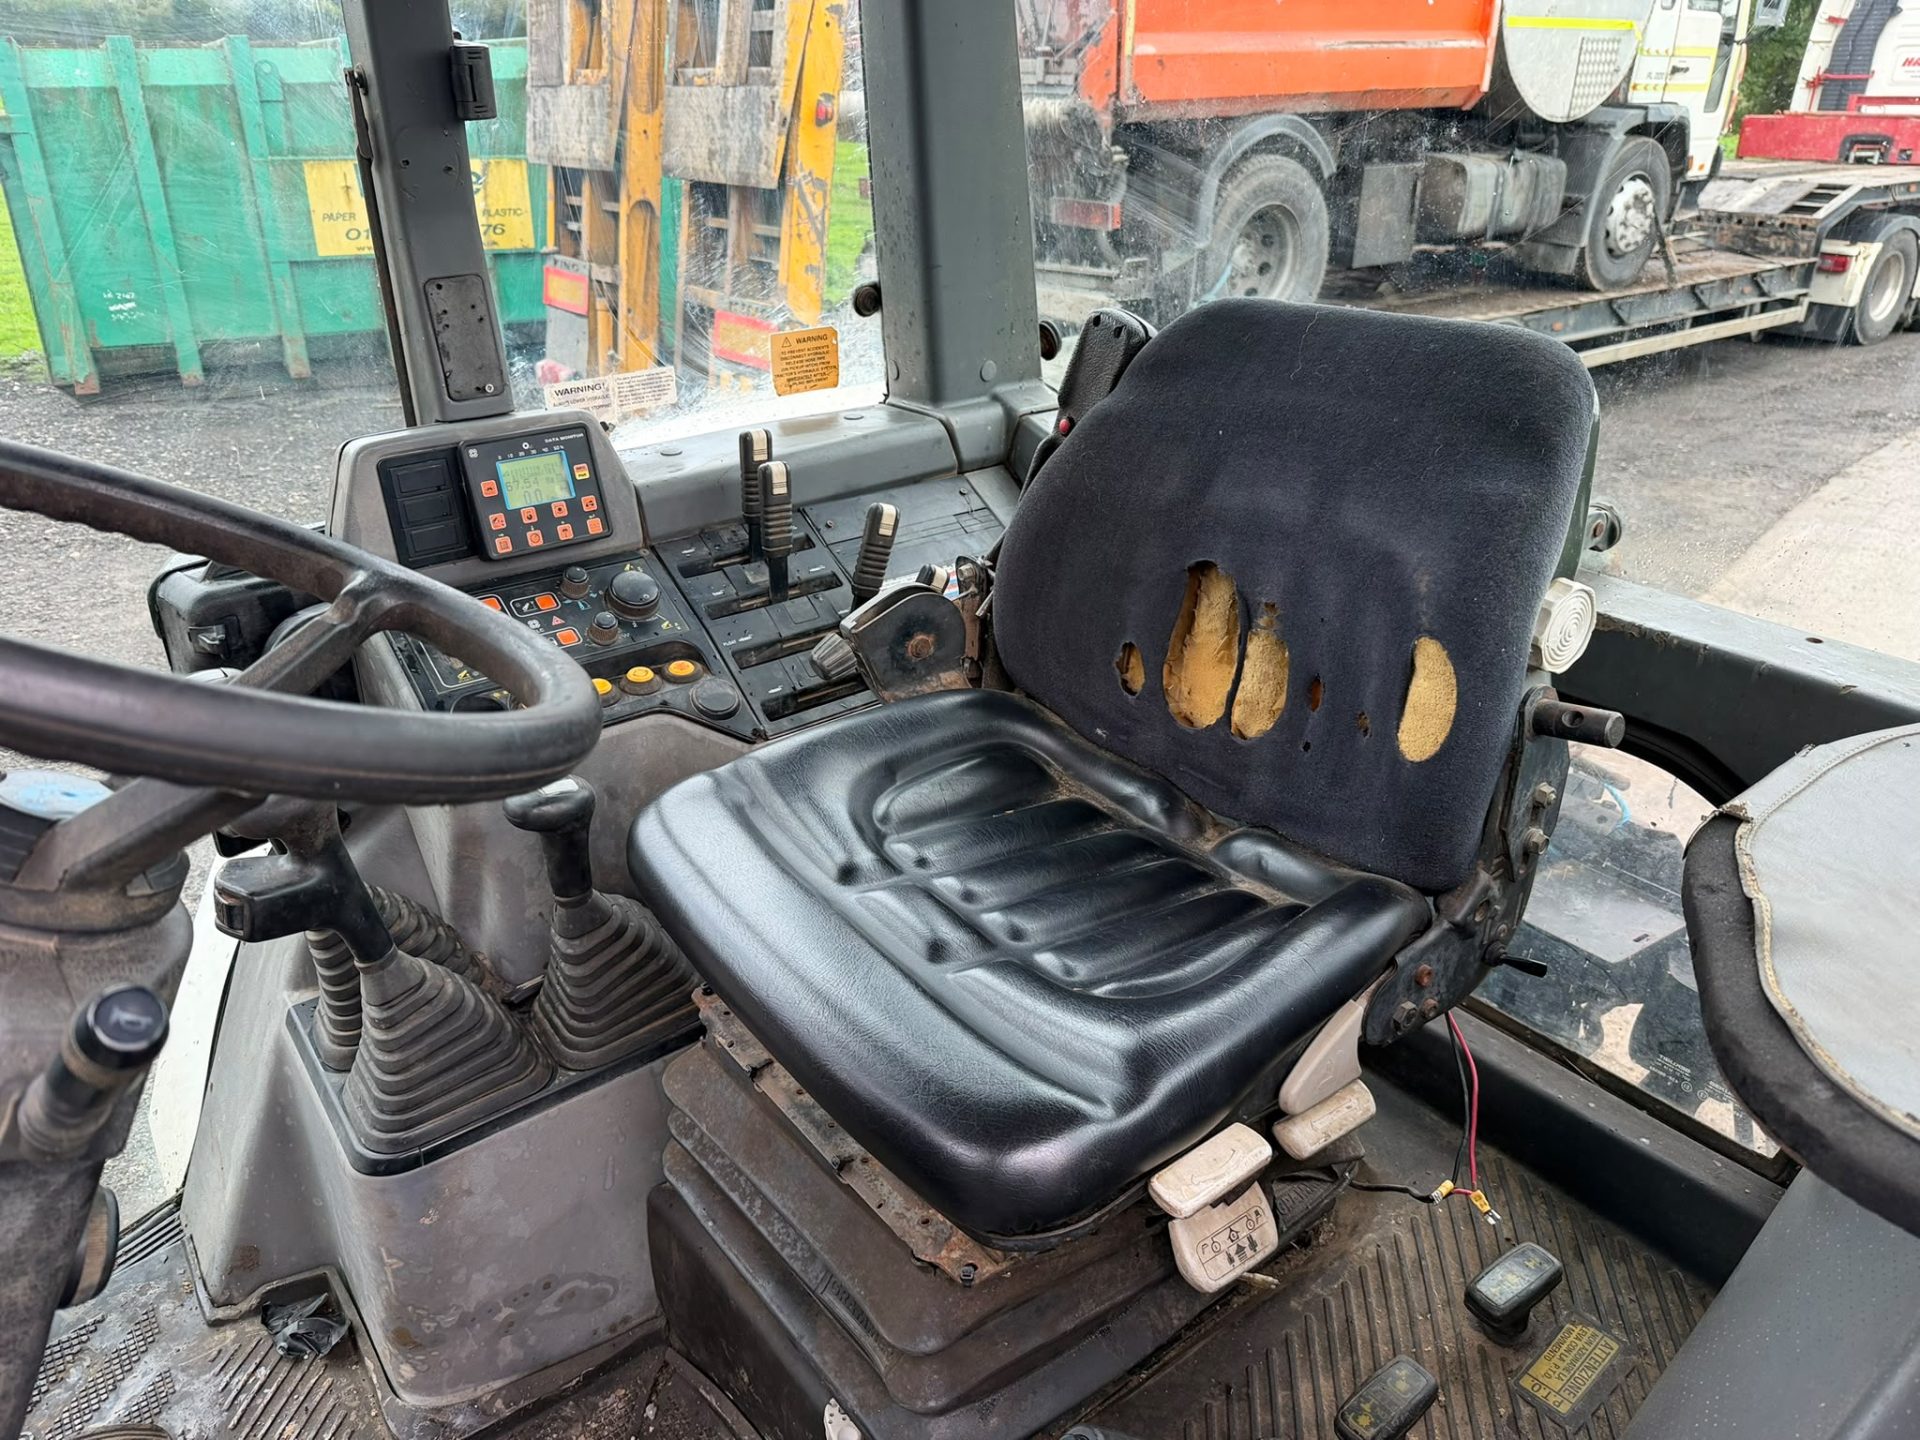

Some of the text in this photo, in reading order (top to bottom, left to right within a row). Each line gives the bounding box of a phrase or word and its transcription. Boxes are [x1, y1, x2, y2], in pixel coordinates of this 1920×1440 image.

[322, 207, 523, 223] PAPER PLASTIC
[796, 334, 828, 344] WARNING
[554, 382, 605, 396] WARNING!
[1544, 1328, 1576, 1362] MOVIMENTO
[1562, 1346, 1589, 1374] AZIONARE
[1563, 1340, 1614, 1399] ATTENZIONE
[1531, 1378, 1564, 1408] P.T.O.
